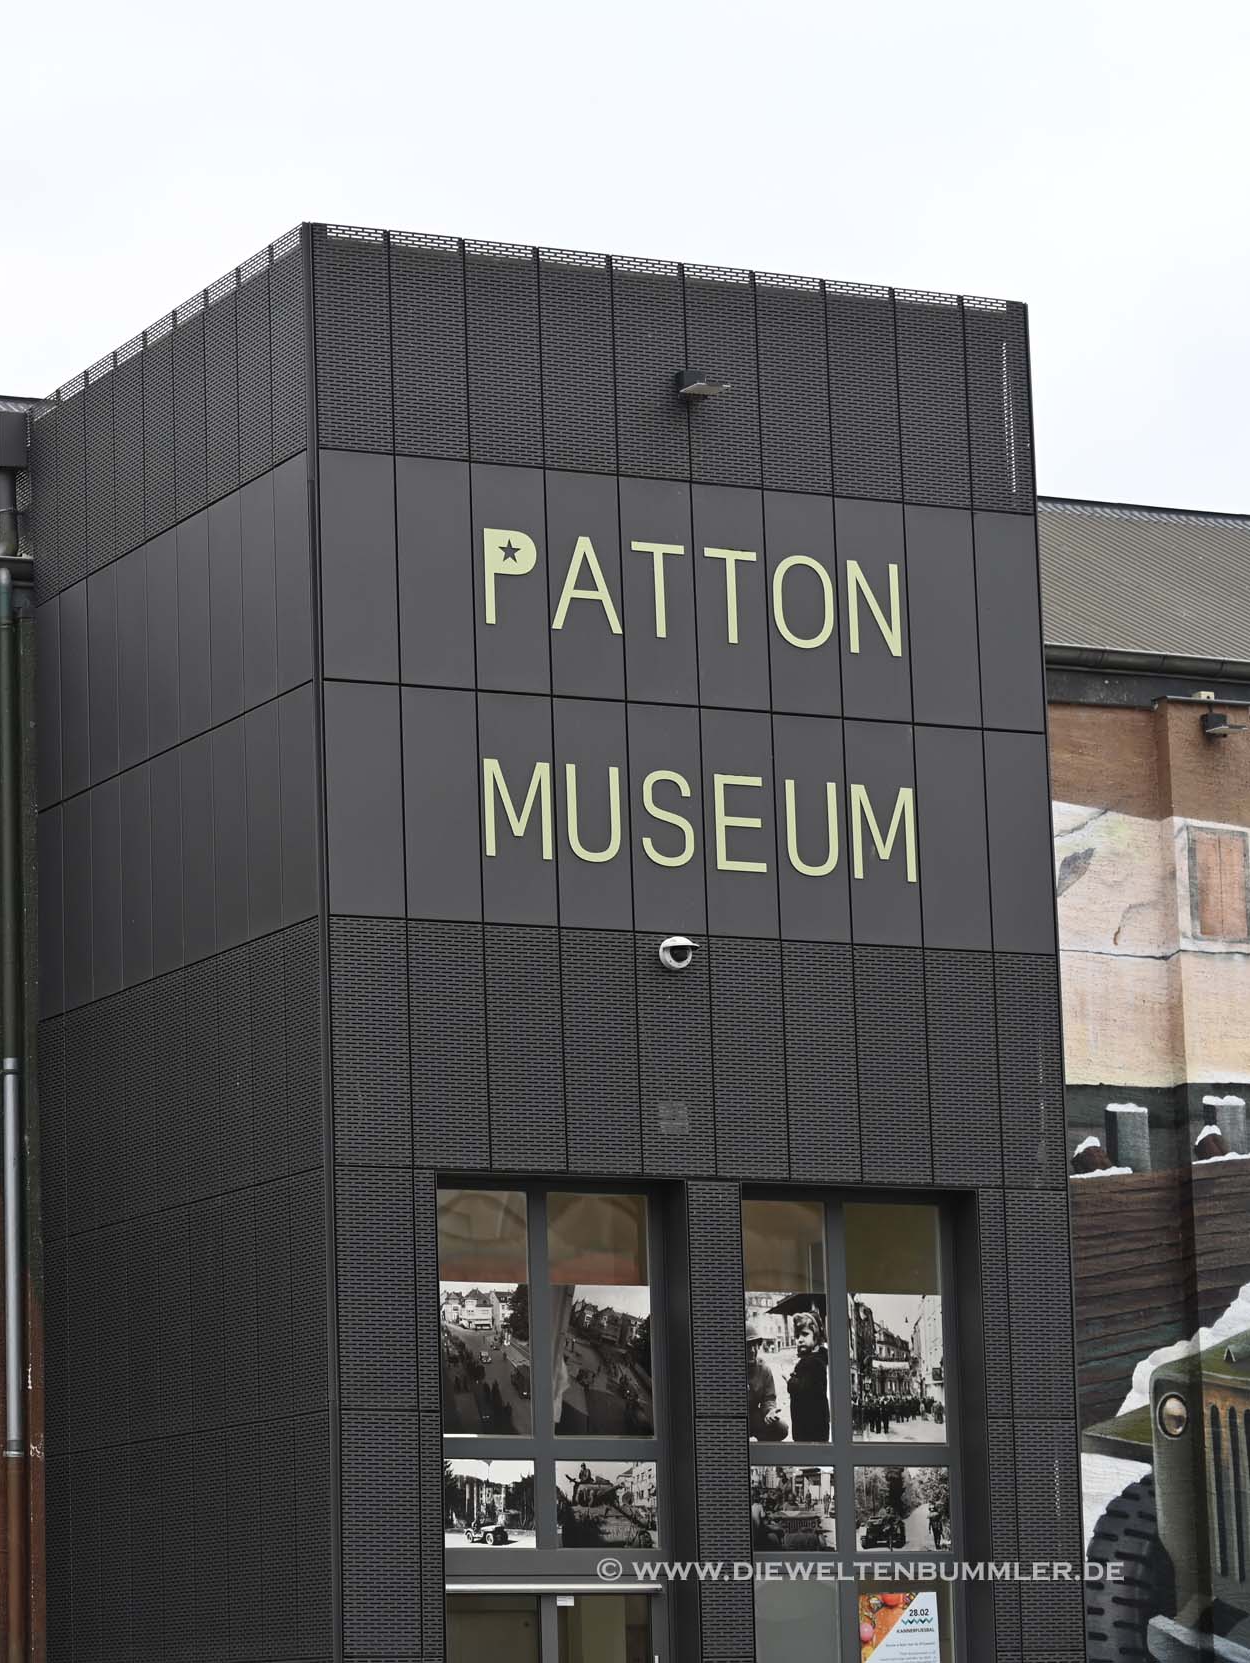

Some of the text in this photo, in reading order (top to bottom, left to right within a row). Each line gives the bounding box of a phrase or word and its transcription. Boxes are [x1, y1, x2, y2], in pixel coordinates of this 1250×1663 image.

[483, 527, 902, 657] PATTON
[483, 757, 917, 883] MUSEUM
[909, 1608, 930, 1617] 28.02
